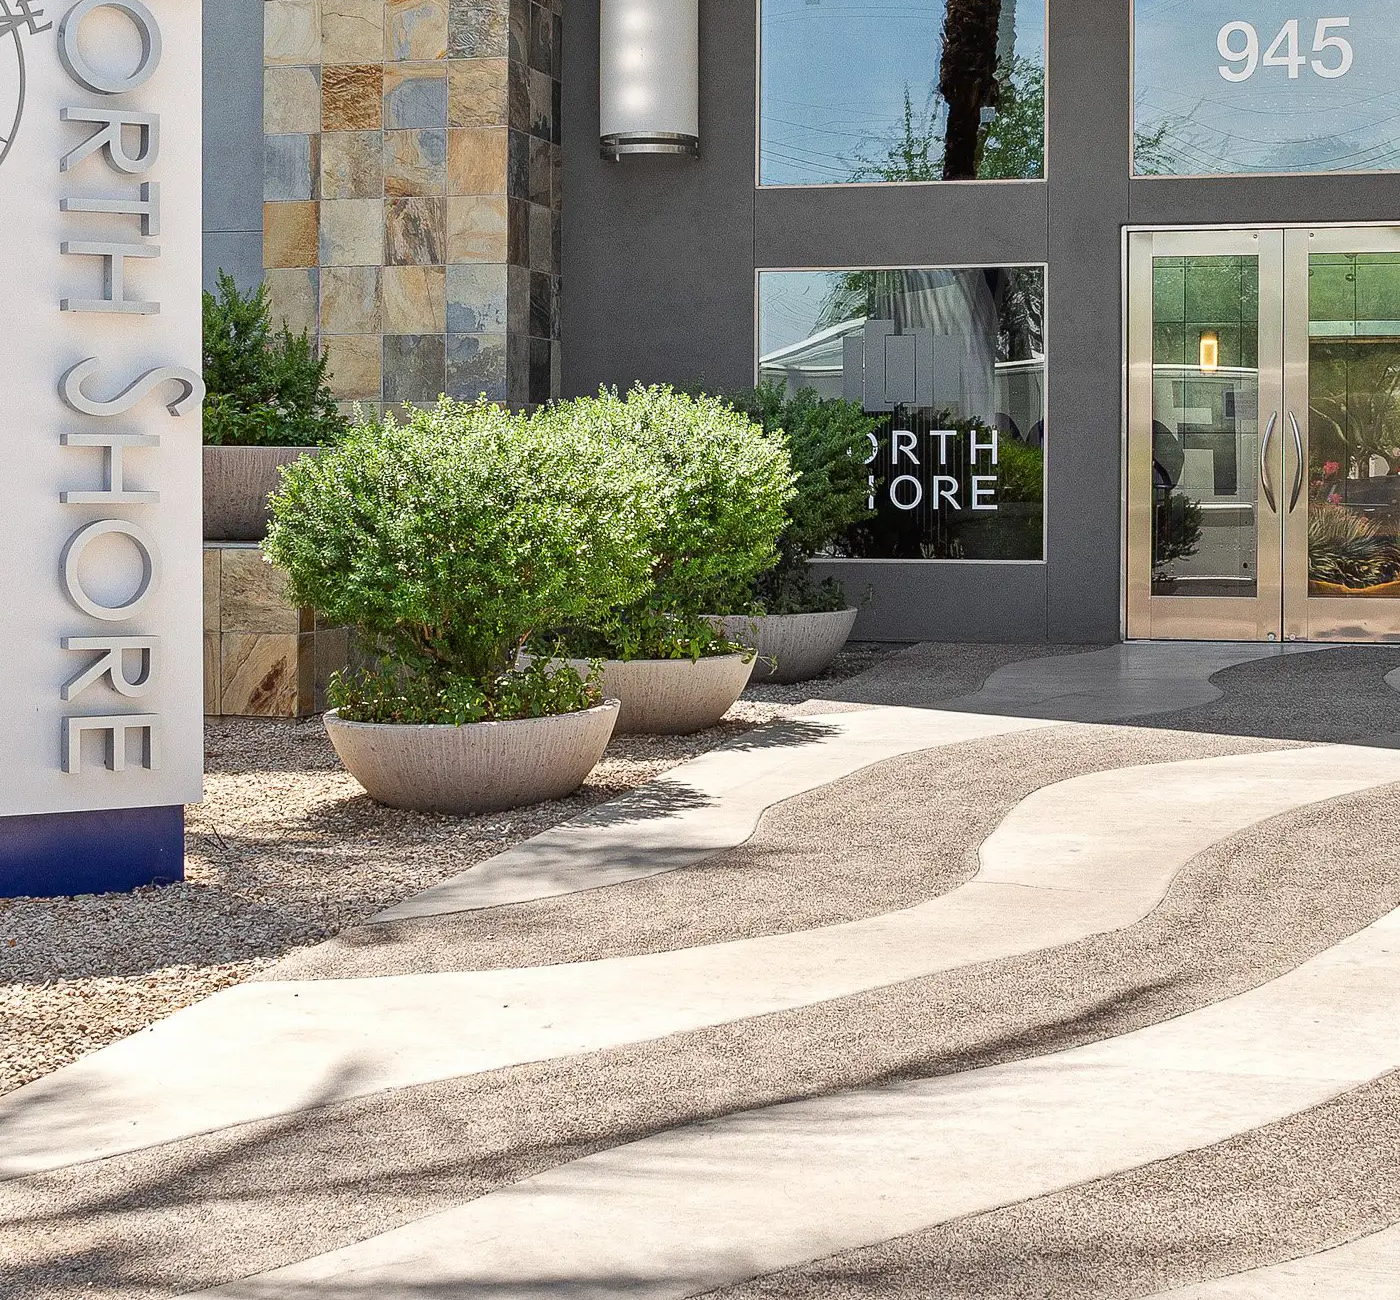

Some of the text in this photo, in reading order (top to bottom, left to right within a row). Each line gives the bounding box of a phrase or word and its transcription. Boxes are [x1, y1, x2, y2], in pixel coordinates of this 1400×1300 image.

[1216, 16, 1354, 83] 945
[847, 429, 999, 465] ORTH
[867, 474, 999, 510] ORE
[58, 356, 206, 775] SHORE
